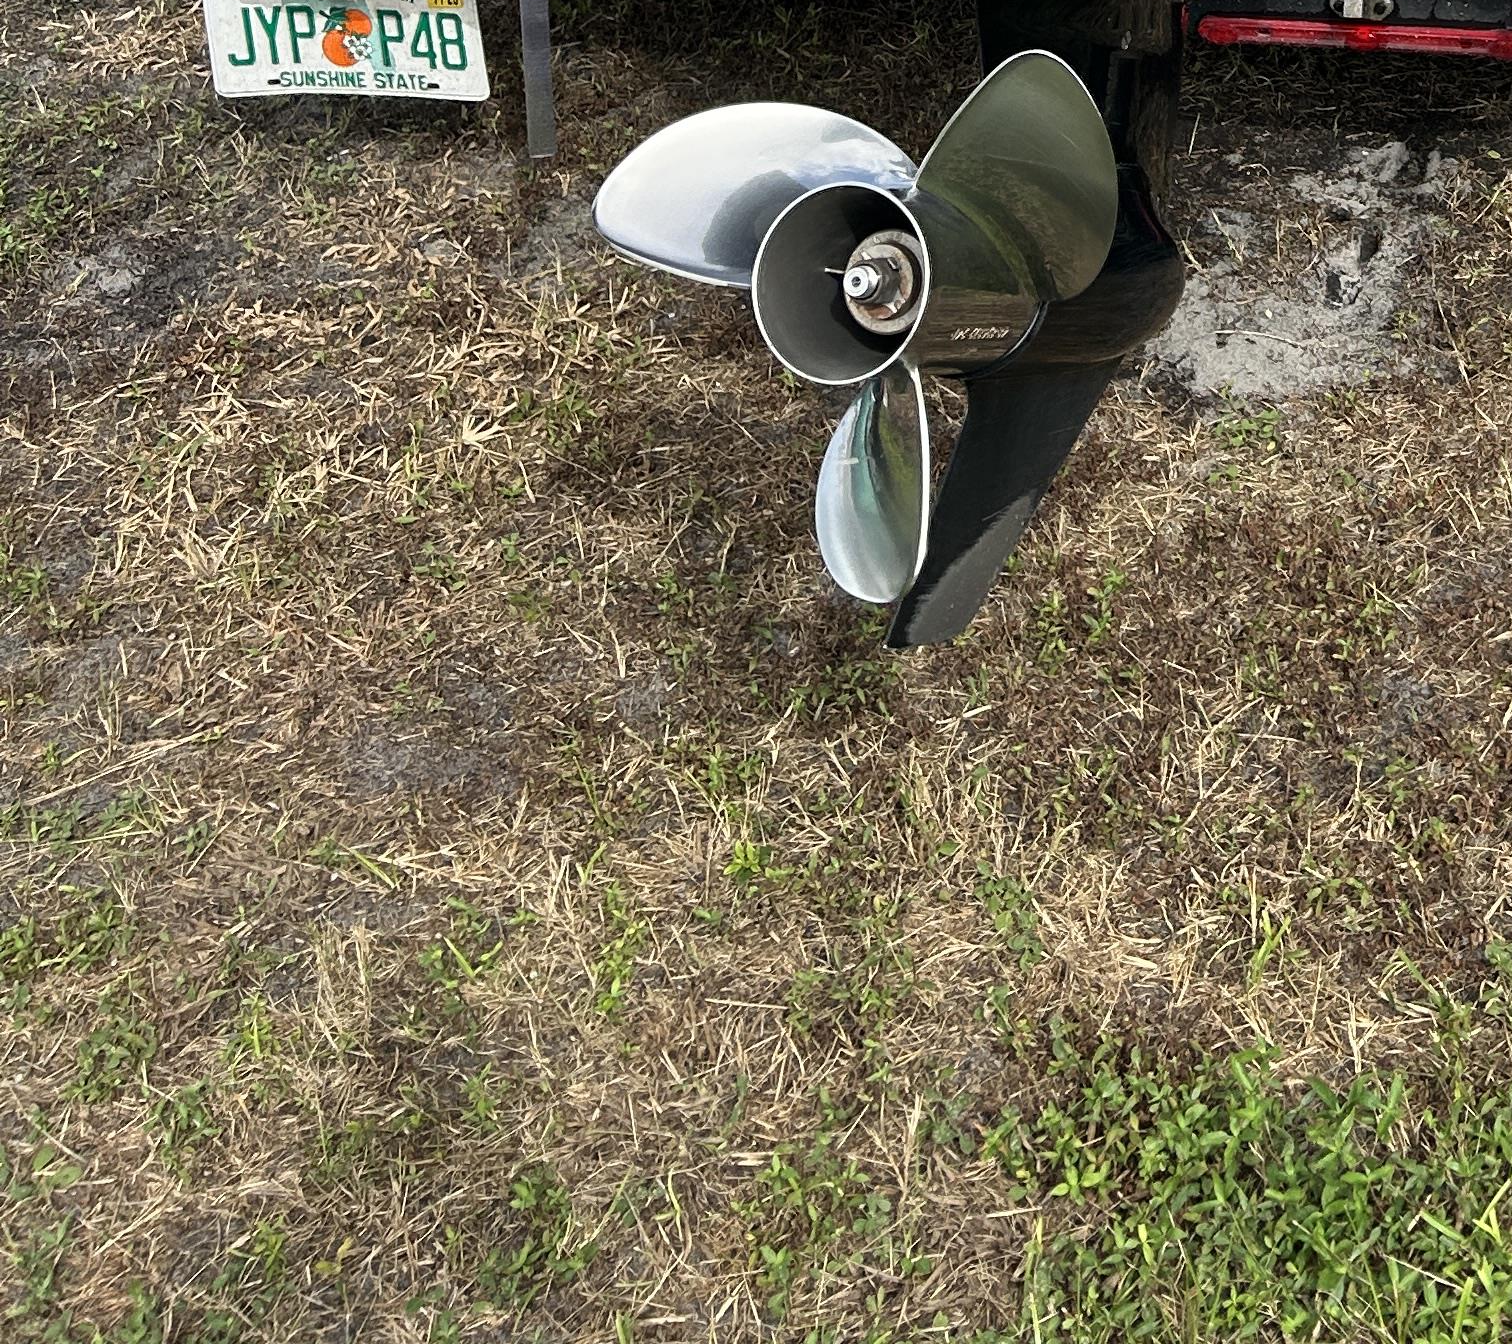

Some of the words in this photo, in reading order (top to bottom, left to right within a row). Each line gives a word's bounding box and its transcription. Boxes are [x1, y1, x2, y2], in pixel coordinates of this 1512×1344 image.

[228, 3, 318, 67] JYP
[376, 8, 468, 72] P48
[279, 70, 368, 89] SUNSHINE
[374, 72, 428, 91] STATE
